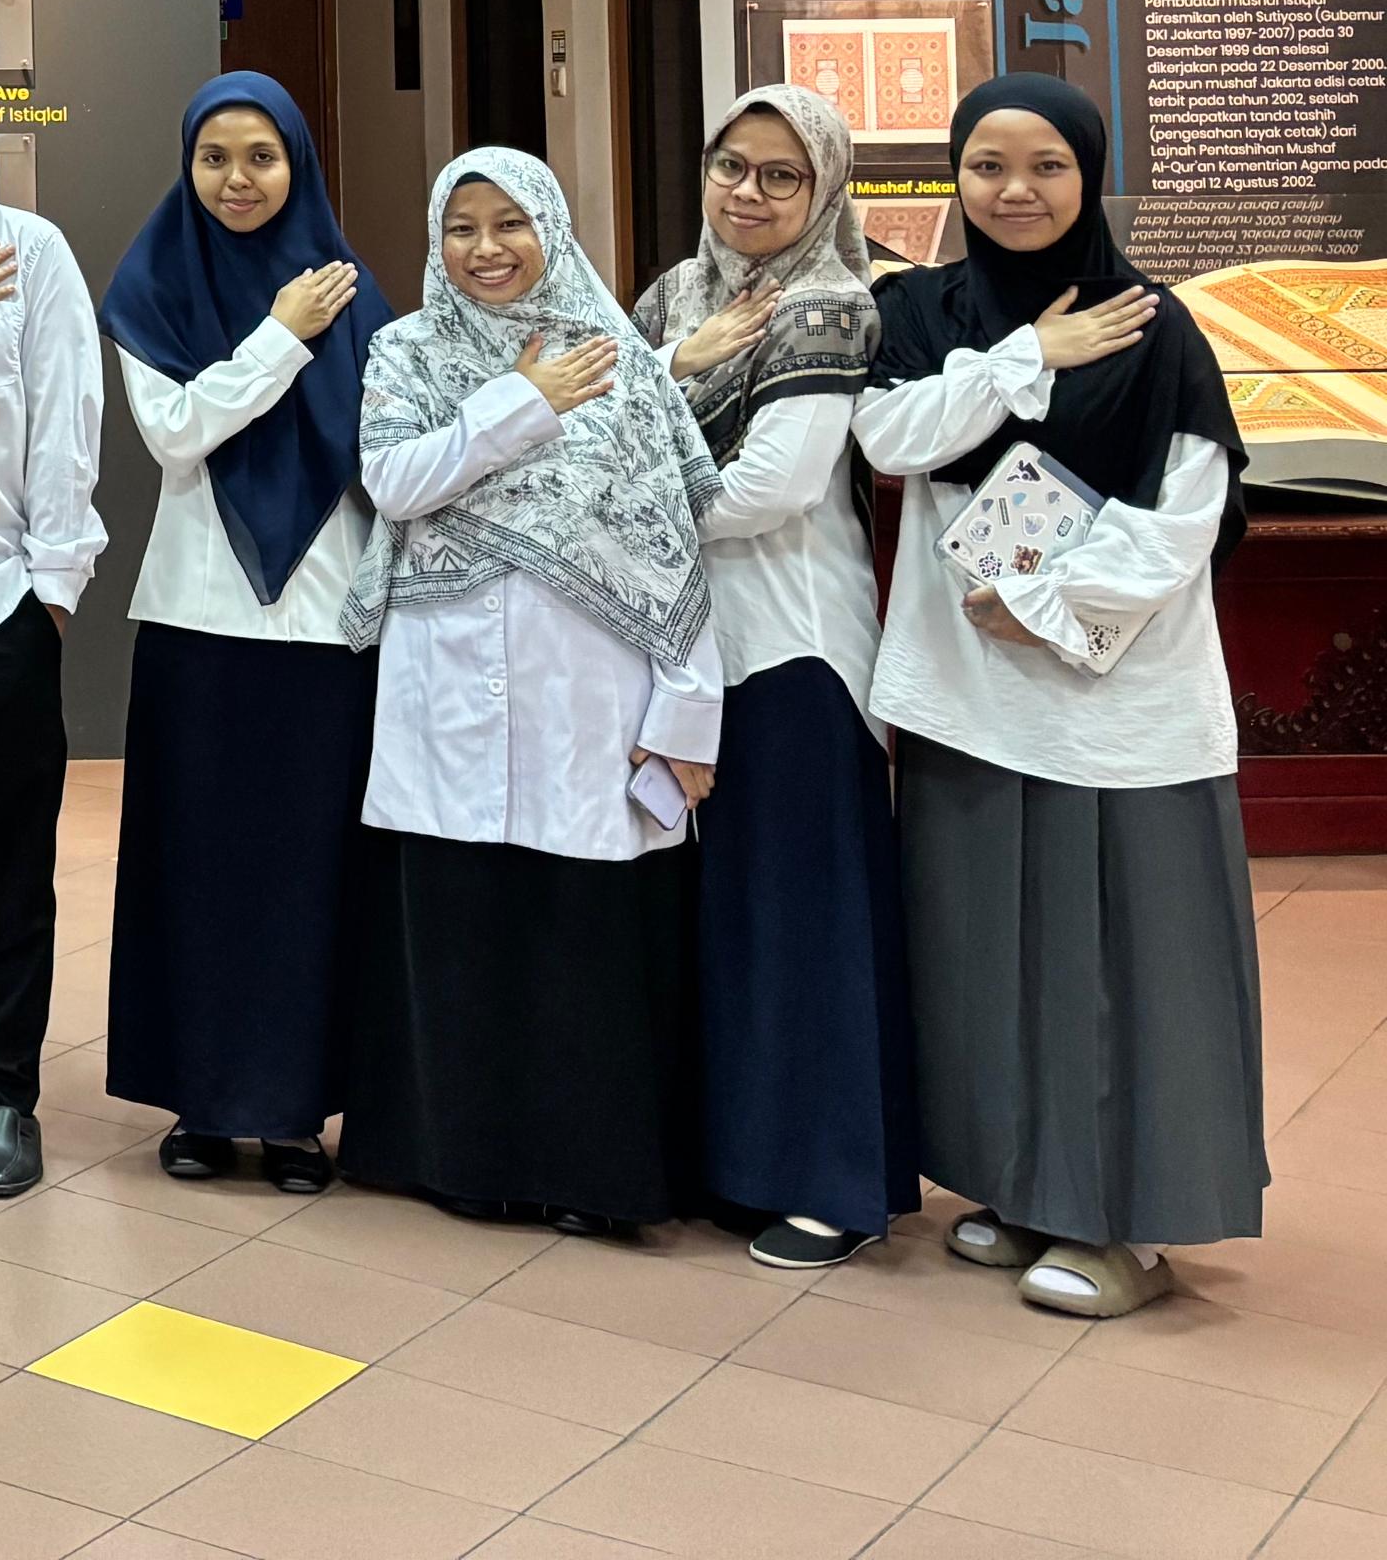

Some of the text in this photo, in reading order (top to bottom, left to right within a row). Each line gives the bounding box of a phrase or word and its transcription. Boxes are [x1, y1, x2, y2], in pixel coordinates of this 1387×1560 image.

[1145, 11, 1221, 24] diresmikan
[1223, 10, 1253, 23] oleh
[1255, 9, 1313, 26] Sutiyoso
[1146, 28, 1168, 40] DKI
[1170, 27, 1222, 40] Jakarta
[1297, 26, 1335, 42] pada
[1337, 27, 1354, 39] 30
[1146, 42, 1329, 57] Desember 1999 dan selesai
[1147, 61, 1218, 78] dikerjakan
[1220, 60, 1258, 77] pada
[1260, 61, 1277, 73] 22
[1278, 58, 1349, 72] Desember
[1147, 74, 1386, 94] Adapun mushaf Jakarta edisi cetak
[1148, 91, 1359, 110] terbit pada tahun 2002, setelah
[10, 106, 68, 127] Istiqlal
[1149, 108, 1336, 127] mendapatkan tanda tashih
[1245, 126, 1282, 142] layak
[1329, 124, 1357, 137] dari
[1150, 141, 1337, 160] Lajnah Pentashihan Mushaf
[1218, 158, 1298, 172] Kementrian
[1300, 158, 1351, 174] Agama
[856, 180, 913, 194] Mushaf
[1151, 176, 1316, 193] tanggal 12 Agustus 2002.
